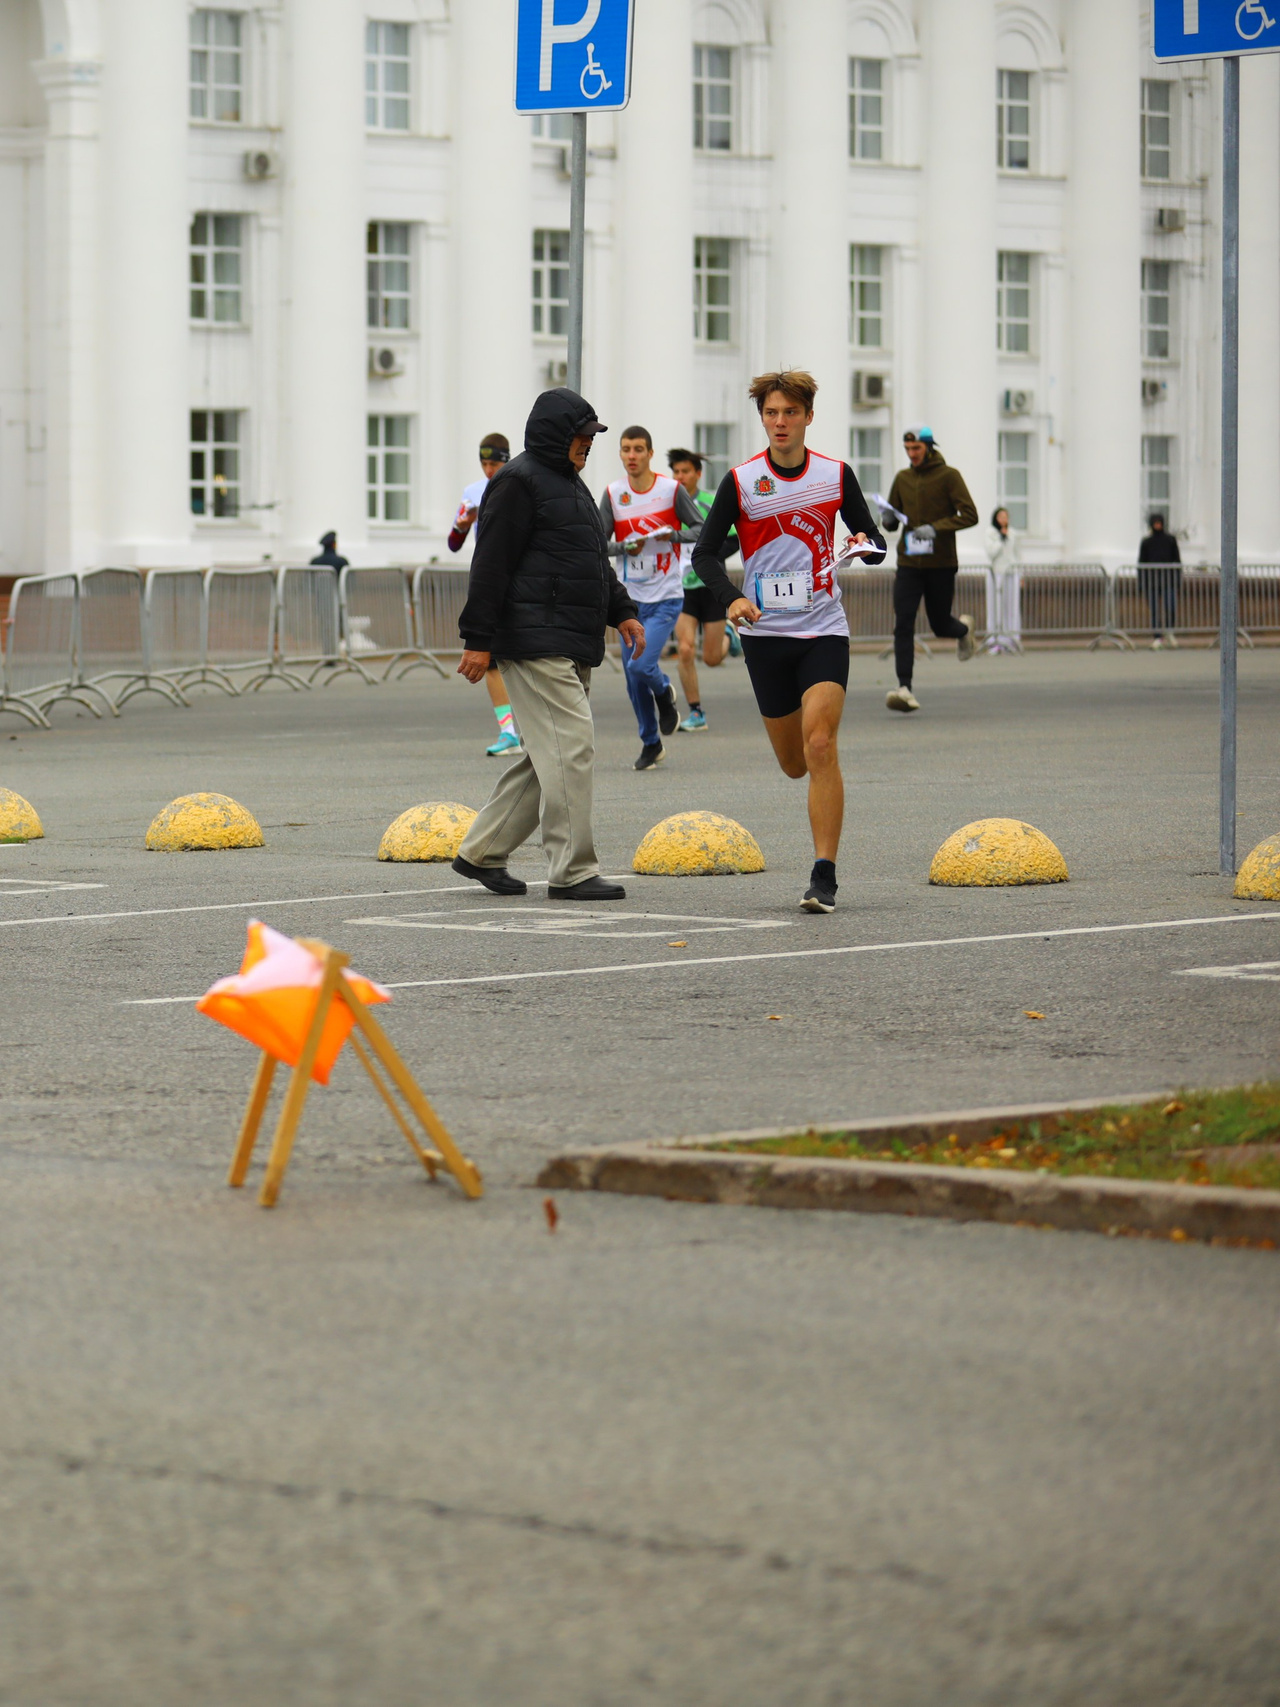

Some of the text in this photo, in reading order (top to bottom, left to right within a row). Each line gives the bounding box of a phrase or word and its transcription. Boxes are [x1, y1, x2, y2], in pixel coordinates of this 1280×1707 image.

[539, 0, 601, 91] P
[790, 514, 815, 534] Run
[813, 533, 827, 554] and
[631, 560, 644, 570] 8.1
[773, 582, 795, 597] 1.1
